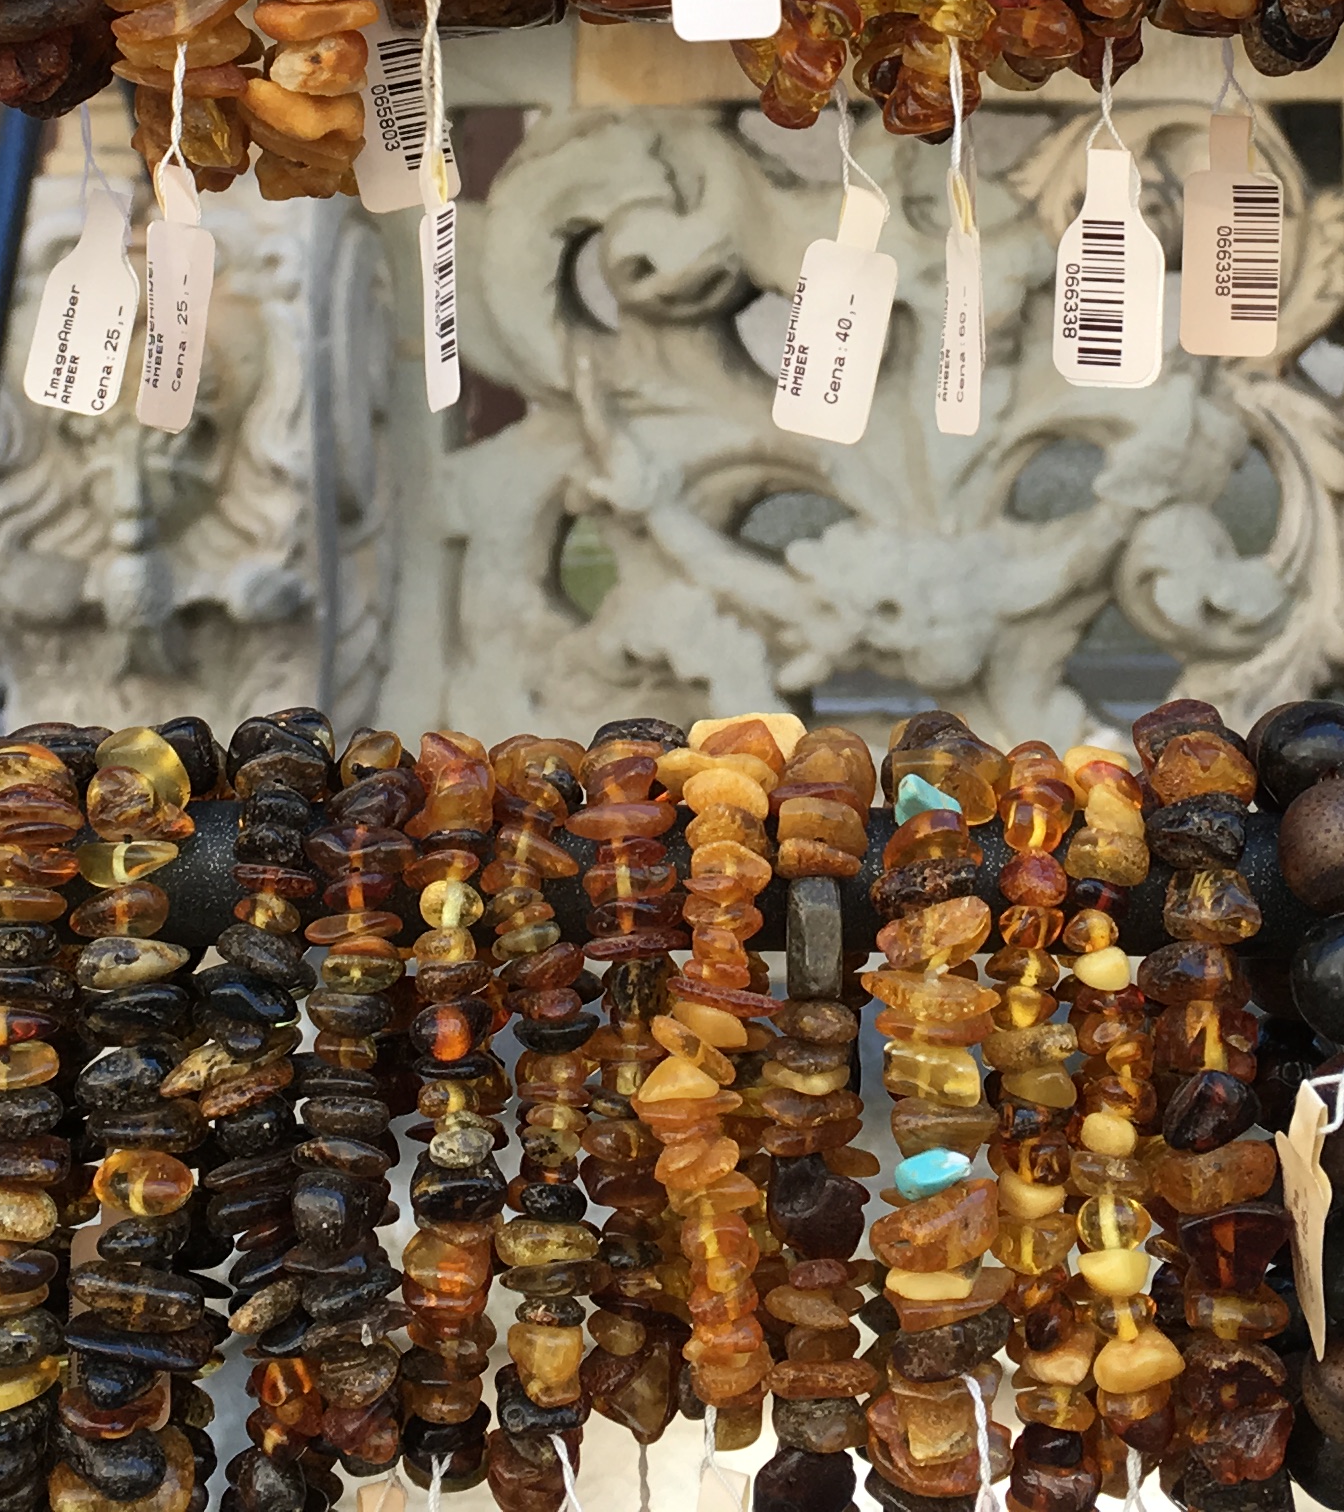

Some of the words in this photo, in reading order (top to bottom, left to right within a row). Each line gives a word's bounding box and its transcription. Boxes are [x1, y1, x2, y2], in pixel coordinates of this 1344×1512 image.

[370, 84, 399, 152] 065803
[1214, 225, 1231, 297] 066338
[1062, 263, 1080, 339] 066338
[44, 284, 80, 399] ImageAmber
[151, 332, 164, 389] AMBER
[789, 345, 810, 396] AMBER
[59, 354, 80, 404] AMBER
